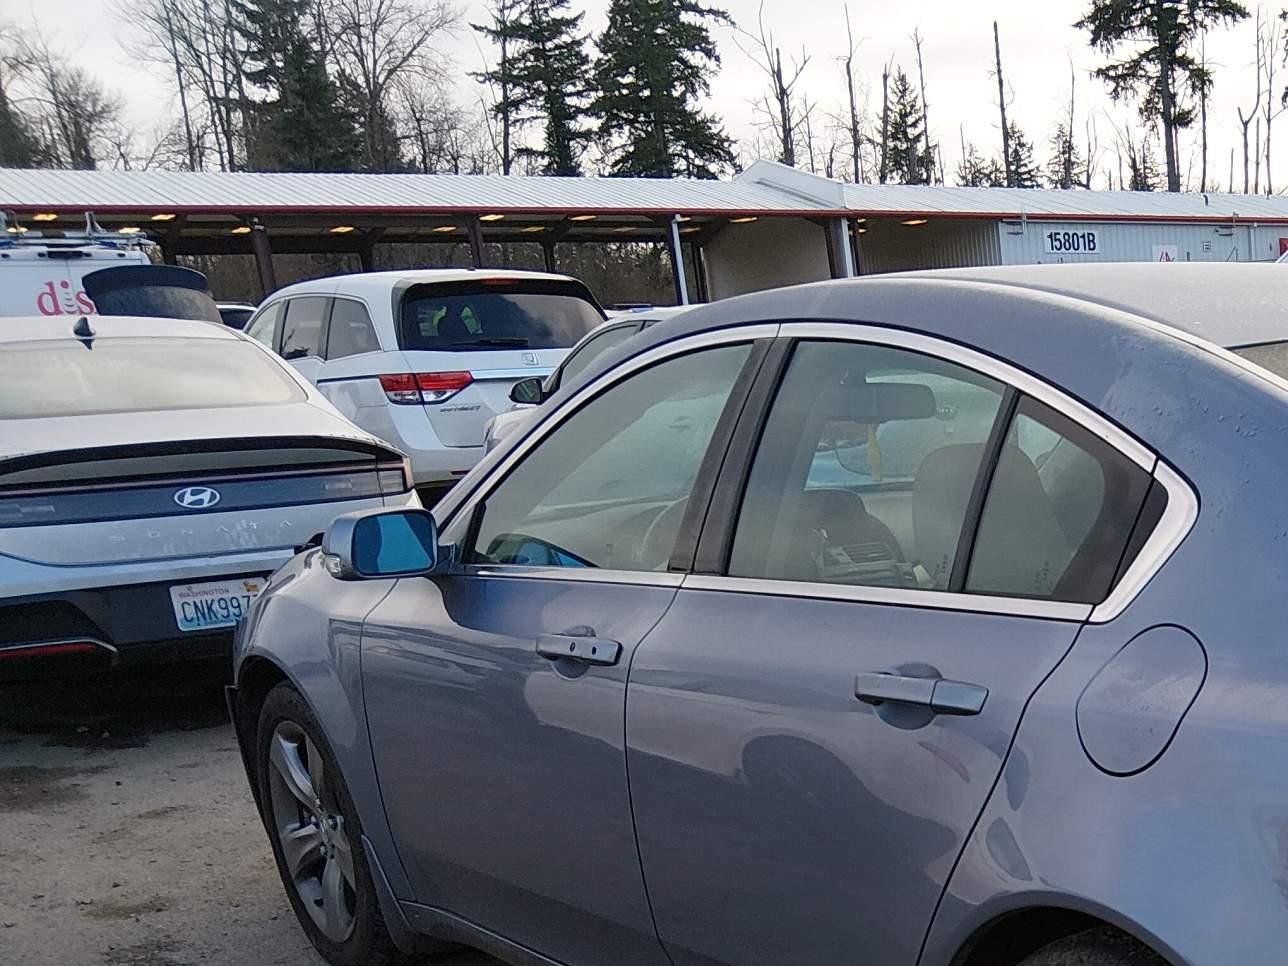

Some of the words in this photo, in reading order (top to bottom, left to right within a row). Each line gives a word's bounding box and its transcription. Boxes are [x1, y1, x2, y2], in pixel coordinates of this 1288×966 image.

[1047, 232, 1096, 251] 15801B
[37, 281, 97, 316] dis
[181, 594, 259, 623] CNK997
